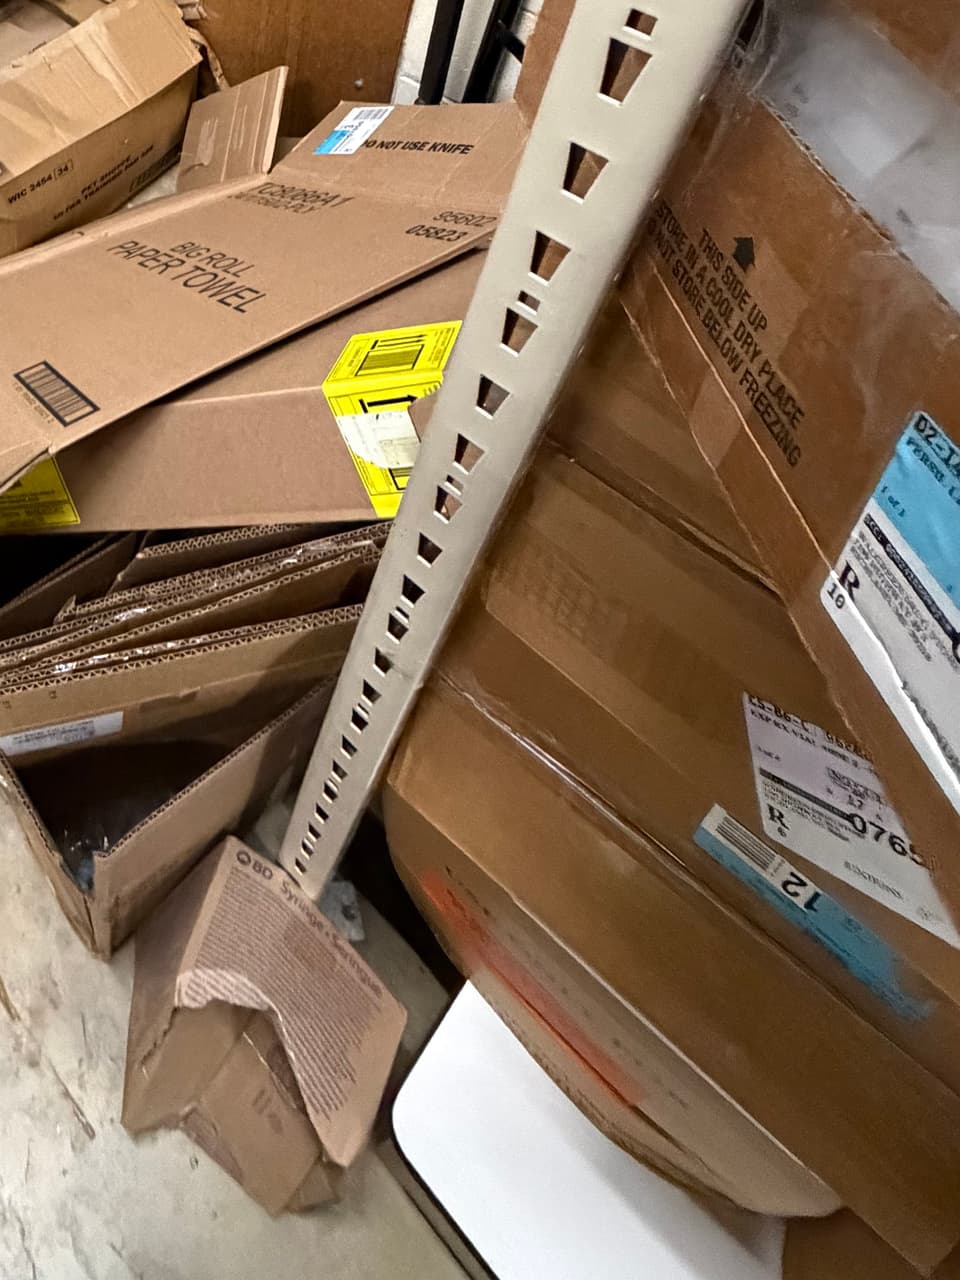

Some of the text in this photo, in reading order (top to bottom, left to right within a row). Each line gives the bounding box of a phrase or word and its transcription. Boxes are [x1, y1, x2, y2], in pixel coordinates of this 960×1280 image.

[376, 140, 402, 151] NOT
[401, 141, 430, 151] USE
[427, 142, 475, 155] KNIFE
[7, 188, 28, 205] WIC
[106, 240, 267, 314] PAPER TOWEL
[169, 241, 256, 278] BIG ROLL
[698, 227, 768, 332] THIS SIDE UP
[655, 203, 805, 430] STORE IN A COOL DRY PLACE
[672, 258, 707, 321] STORE
[701, 307, 744, 374] BELOW
[740, 367, 802, 468] FREEZING
[827, 582, 846, 609] 10
[840, 560, 860, 602] R
[252, 861, 274, 881] BD
[280, 880, 325, 933] Syringe
[782, 871, 823, 913] 12
